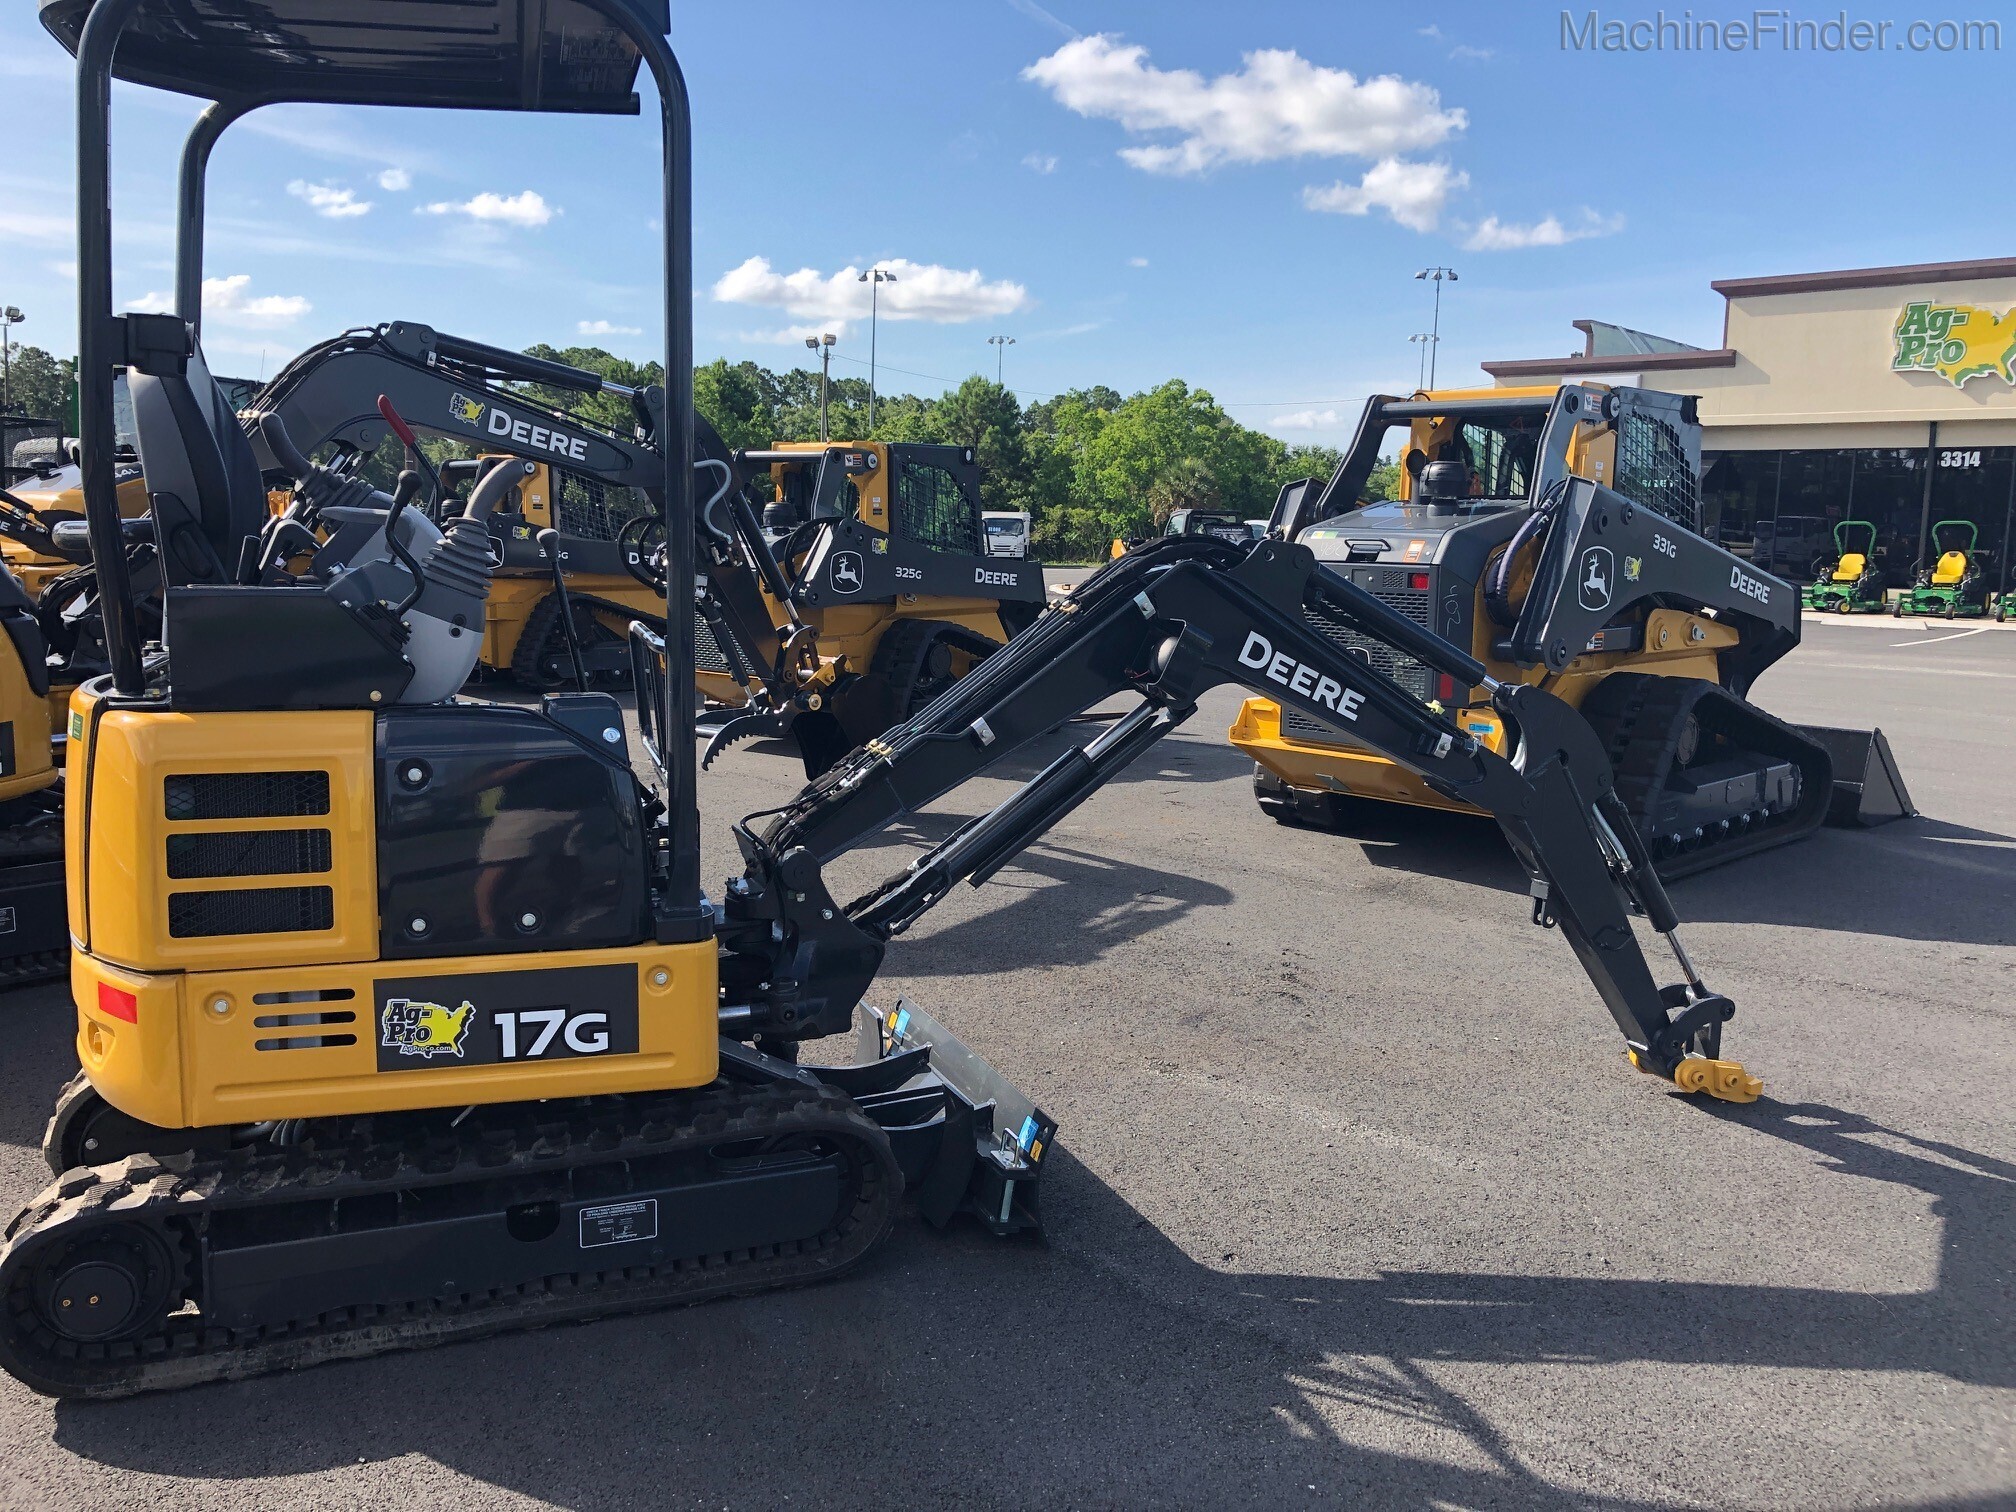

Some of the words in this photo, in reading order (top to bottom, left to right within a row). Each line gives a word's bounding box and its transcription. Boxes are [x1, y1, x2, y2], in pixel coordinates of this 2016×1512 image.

[1897, 302, 1968, 341] Ag-
[1894, 336, 1966, 368] Pro
[488, 408, 588, 461] DEERE
[1940, 451, 1981, 467] 3314
[1652, 533, 1677, 558] 331G
[895, 567, 922, 580] 325G
[974, 567, 1018, 586] DEERE
[1730, 566, 1771, 604] DEERE
[1238, 630, 1366, 721] DEERE
[386, 1002, 431, 1026] Ag-
[386, 1023, 431, 1043] Pro
[494, 1009, 609, 1058] 17G
[403, 1045, 451, 1054] AgProCo.com
